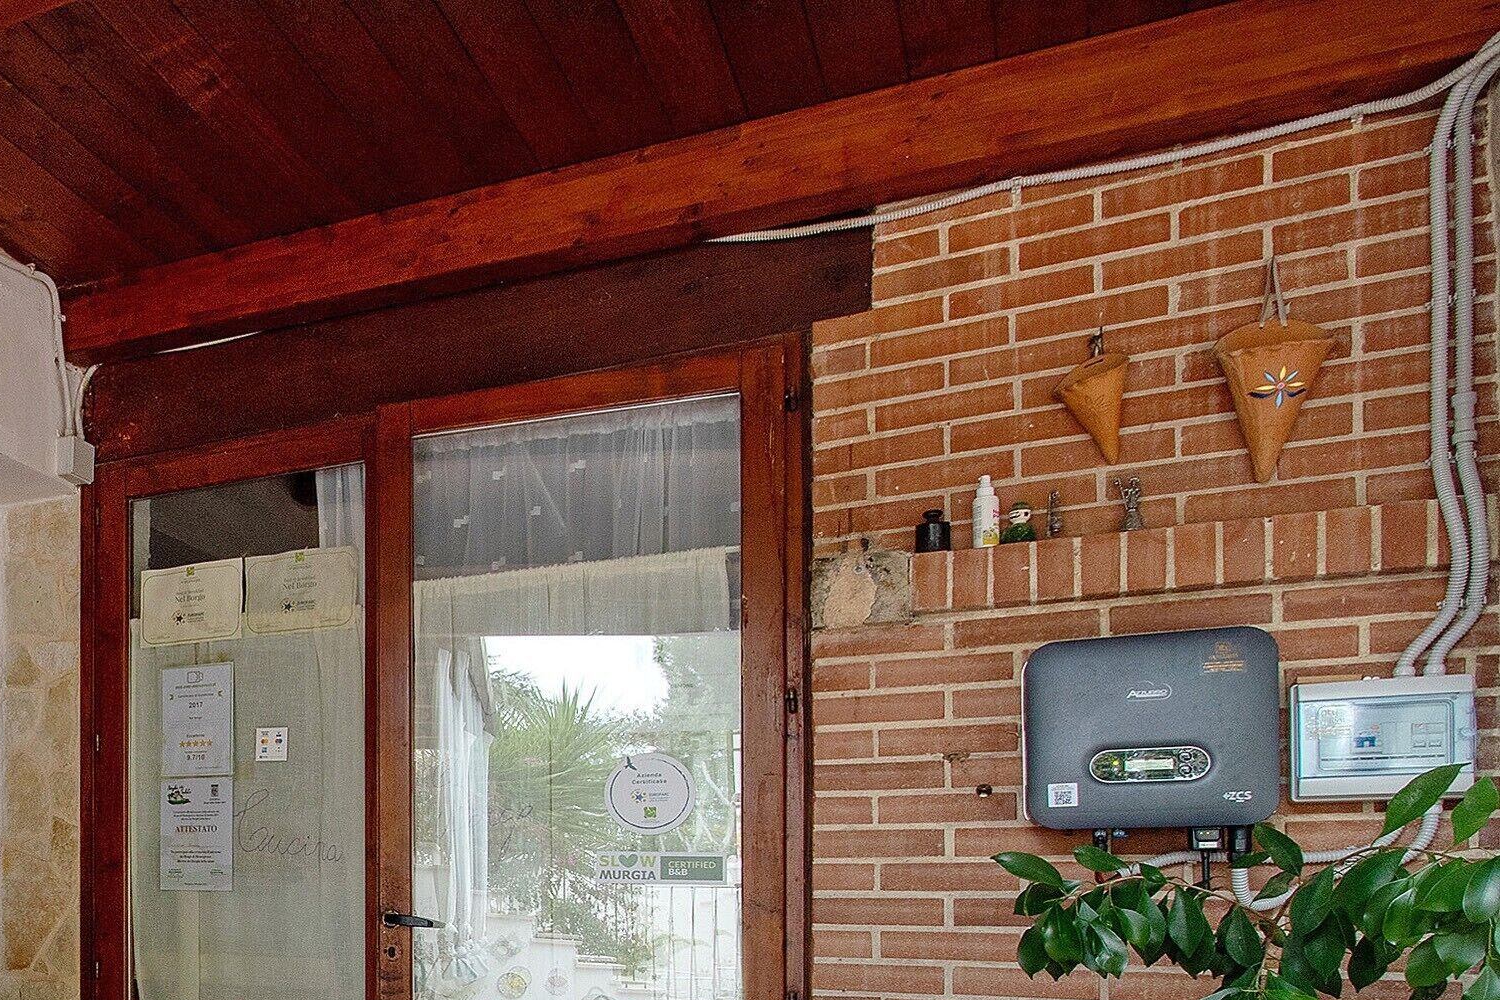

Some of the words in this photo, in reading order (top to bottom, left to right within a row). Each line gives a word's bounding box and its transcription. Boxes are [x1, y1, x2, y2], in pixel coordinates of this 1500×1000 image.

[1229, 790, 1252, 801] ZCS
[175, 825, 218, 833] ATTESTATO
[668, 860, 716, 869] CERTIFIED
[599, 870, 656, 880] MURGIA
[668, 868, 688, 876] B&B
